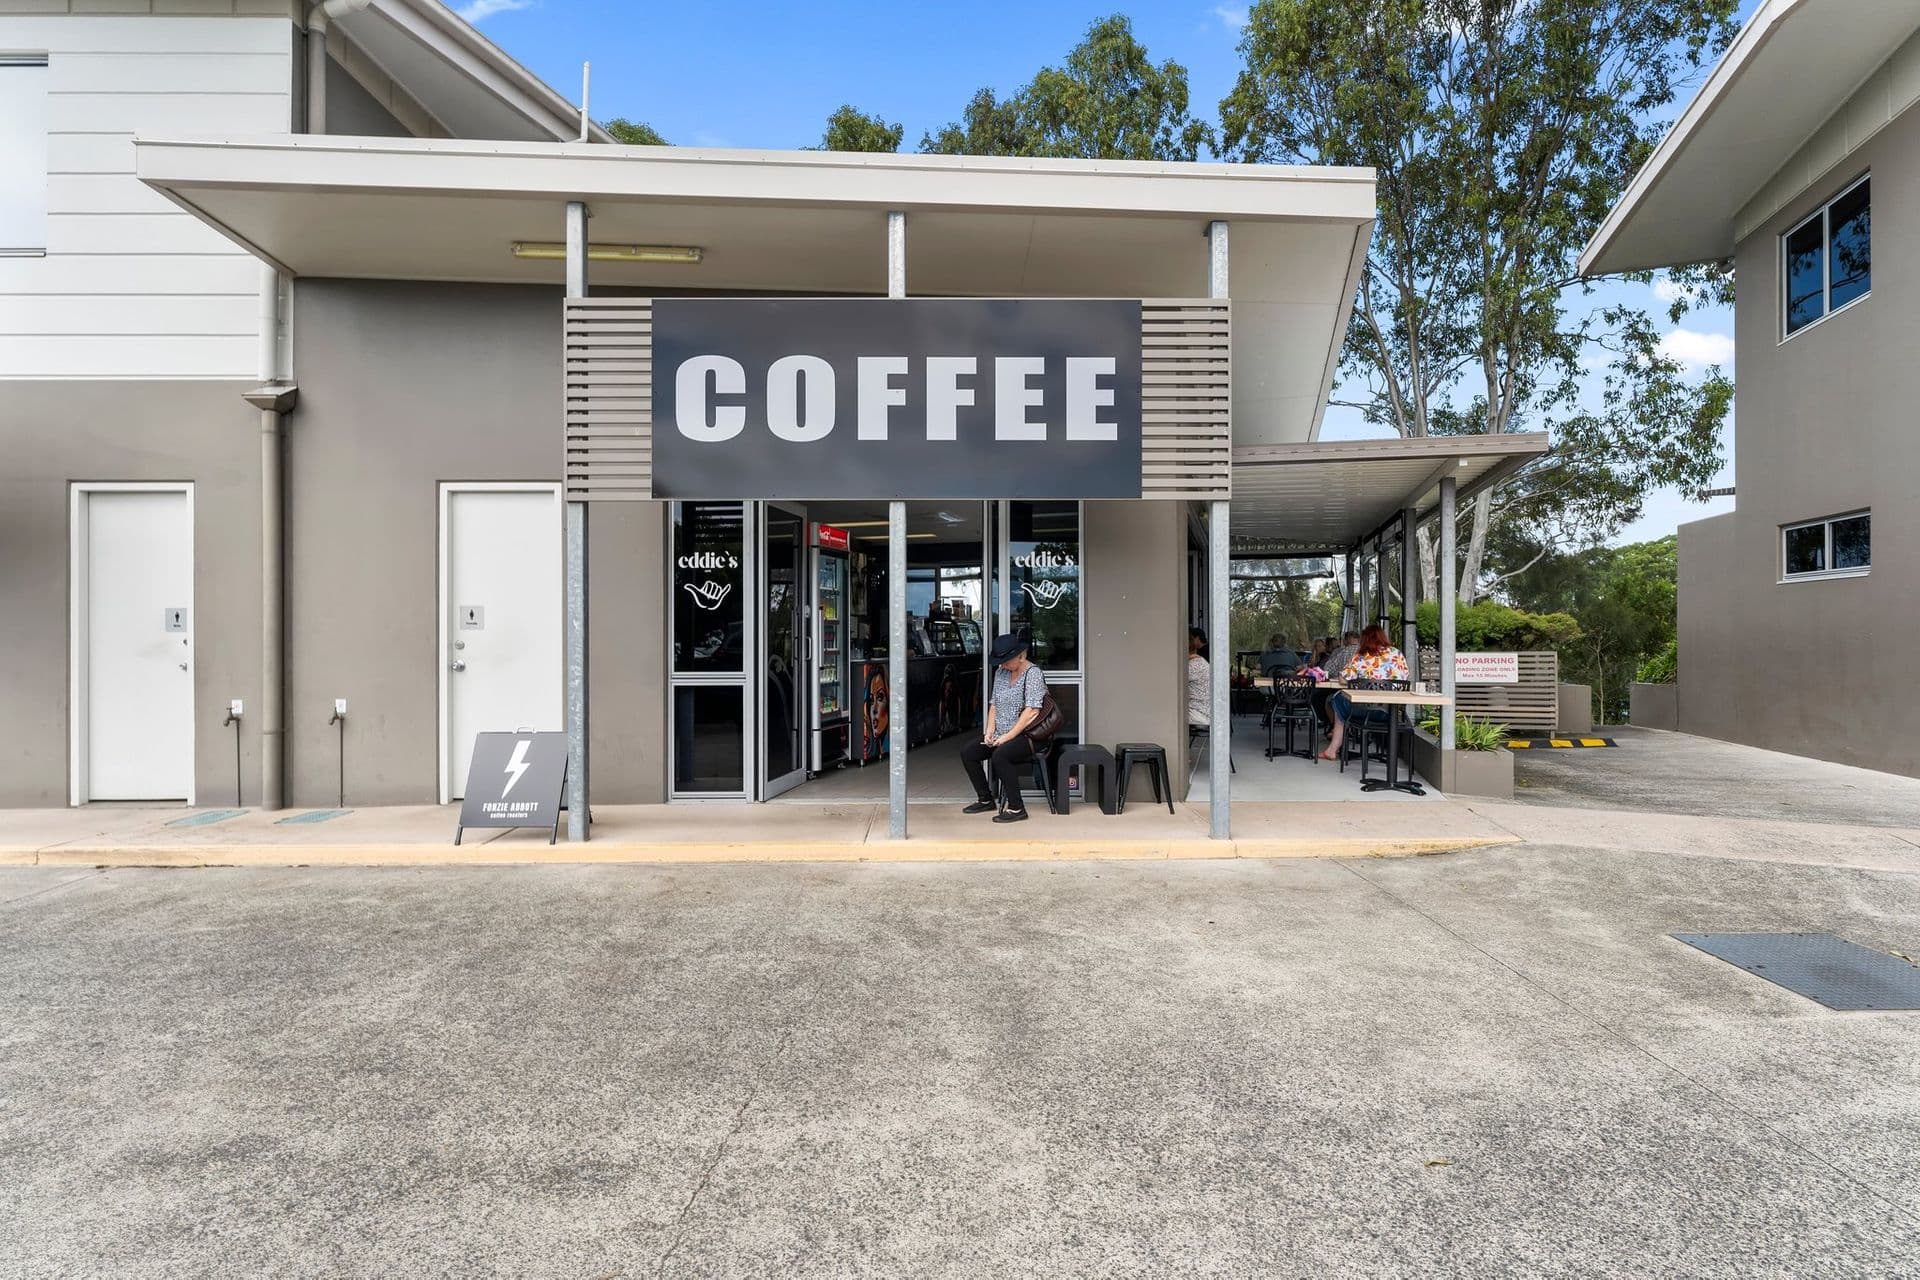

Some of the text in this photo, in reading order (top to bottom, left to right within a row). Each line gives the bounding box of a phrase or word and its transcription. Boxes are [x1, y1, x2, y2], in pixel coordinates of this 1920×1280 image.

[675, 354, 1118, 442] COFFEE
[1471, 657, 1515, 665] PARKING
[510, 802, 539, 812] ABBOTT
